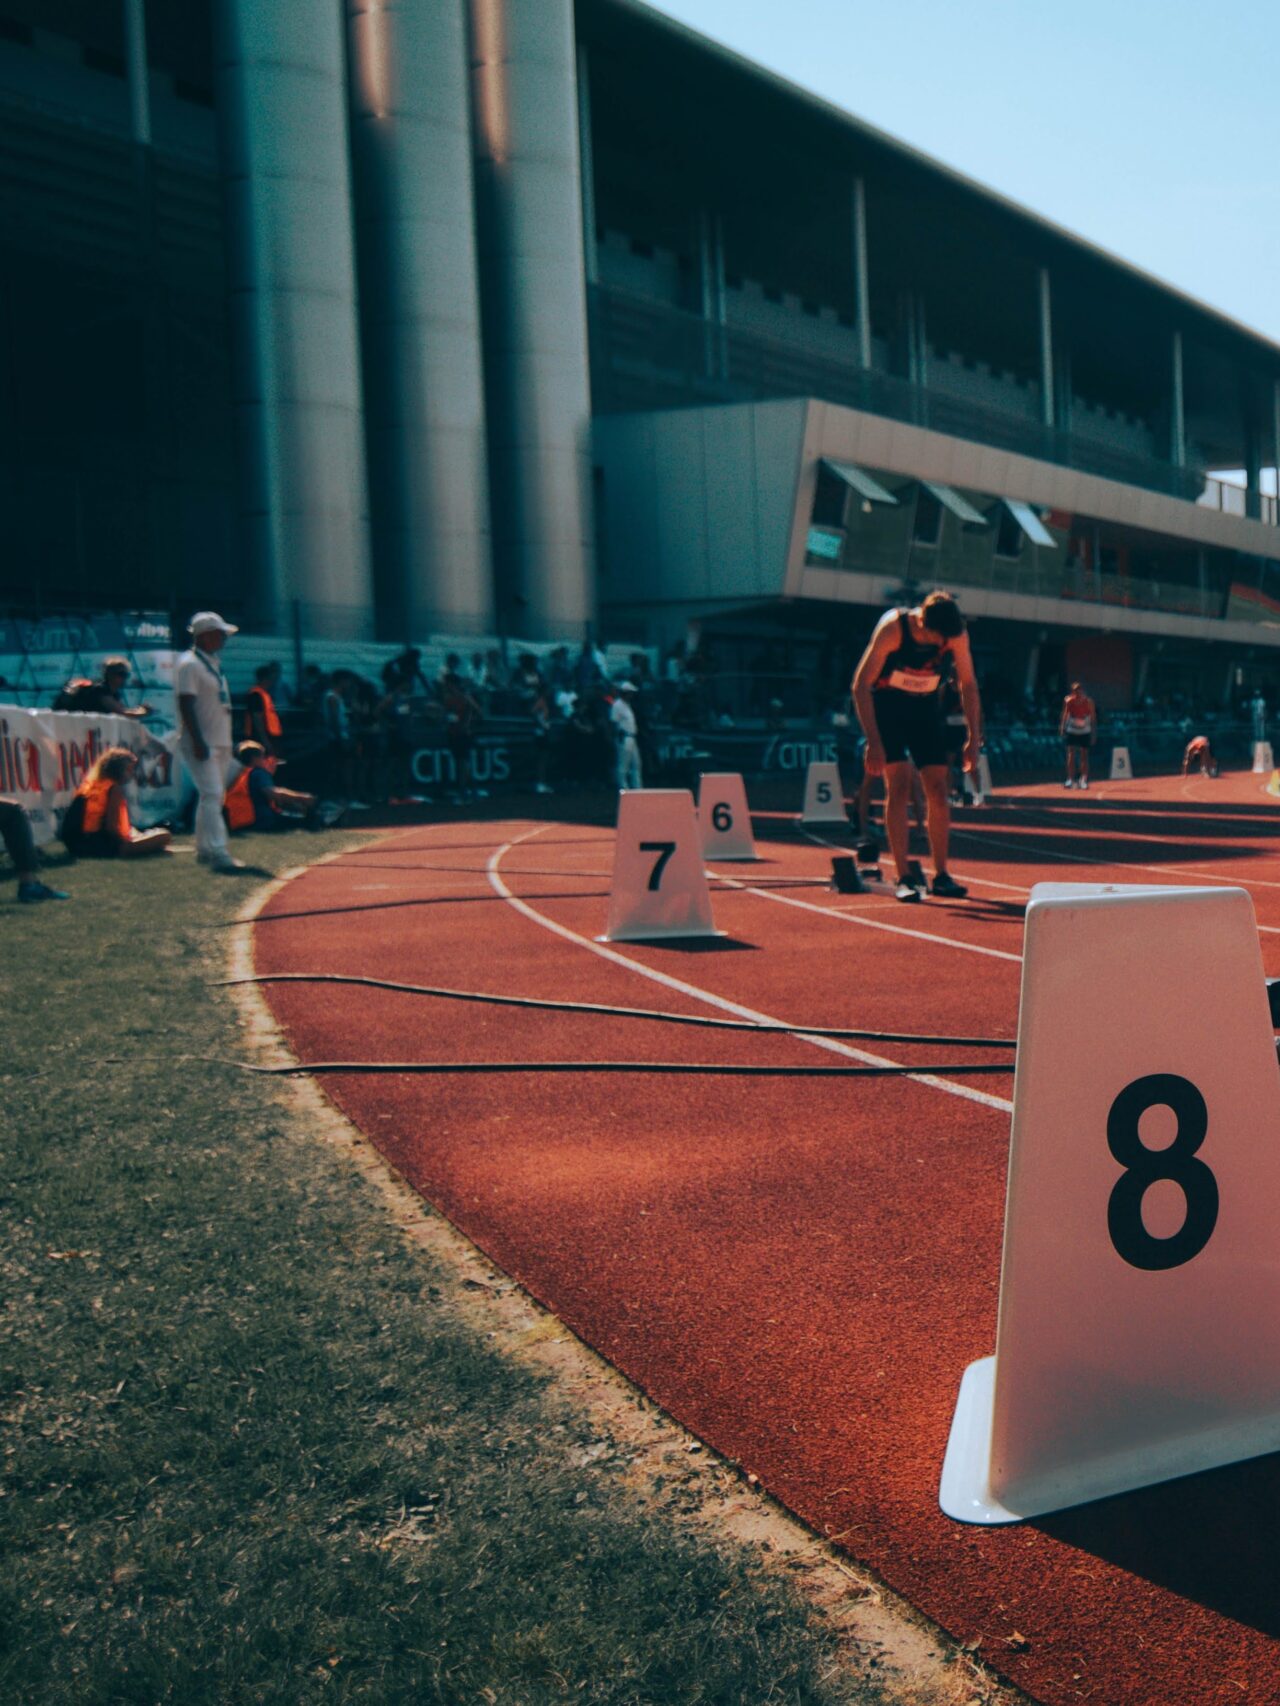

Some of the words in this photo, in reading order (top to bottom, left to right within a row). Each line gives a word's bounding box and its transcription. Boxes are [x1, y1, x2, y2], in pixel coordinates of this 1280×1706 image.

[816, 782, 832, 802] 5
[711, 802, 733, 832] 6
[639, 842, 676, 891] 7
[1107, 1073, 1219, 1271] 8
